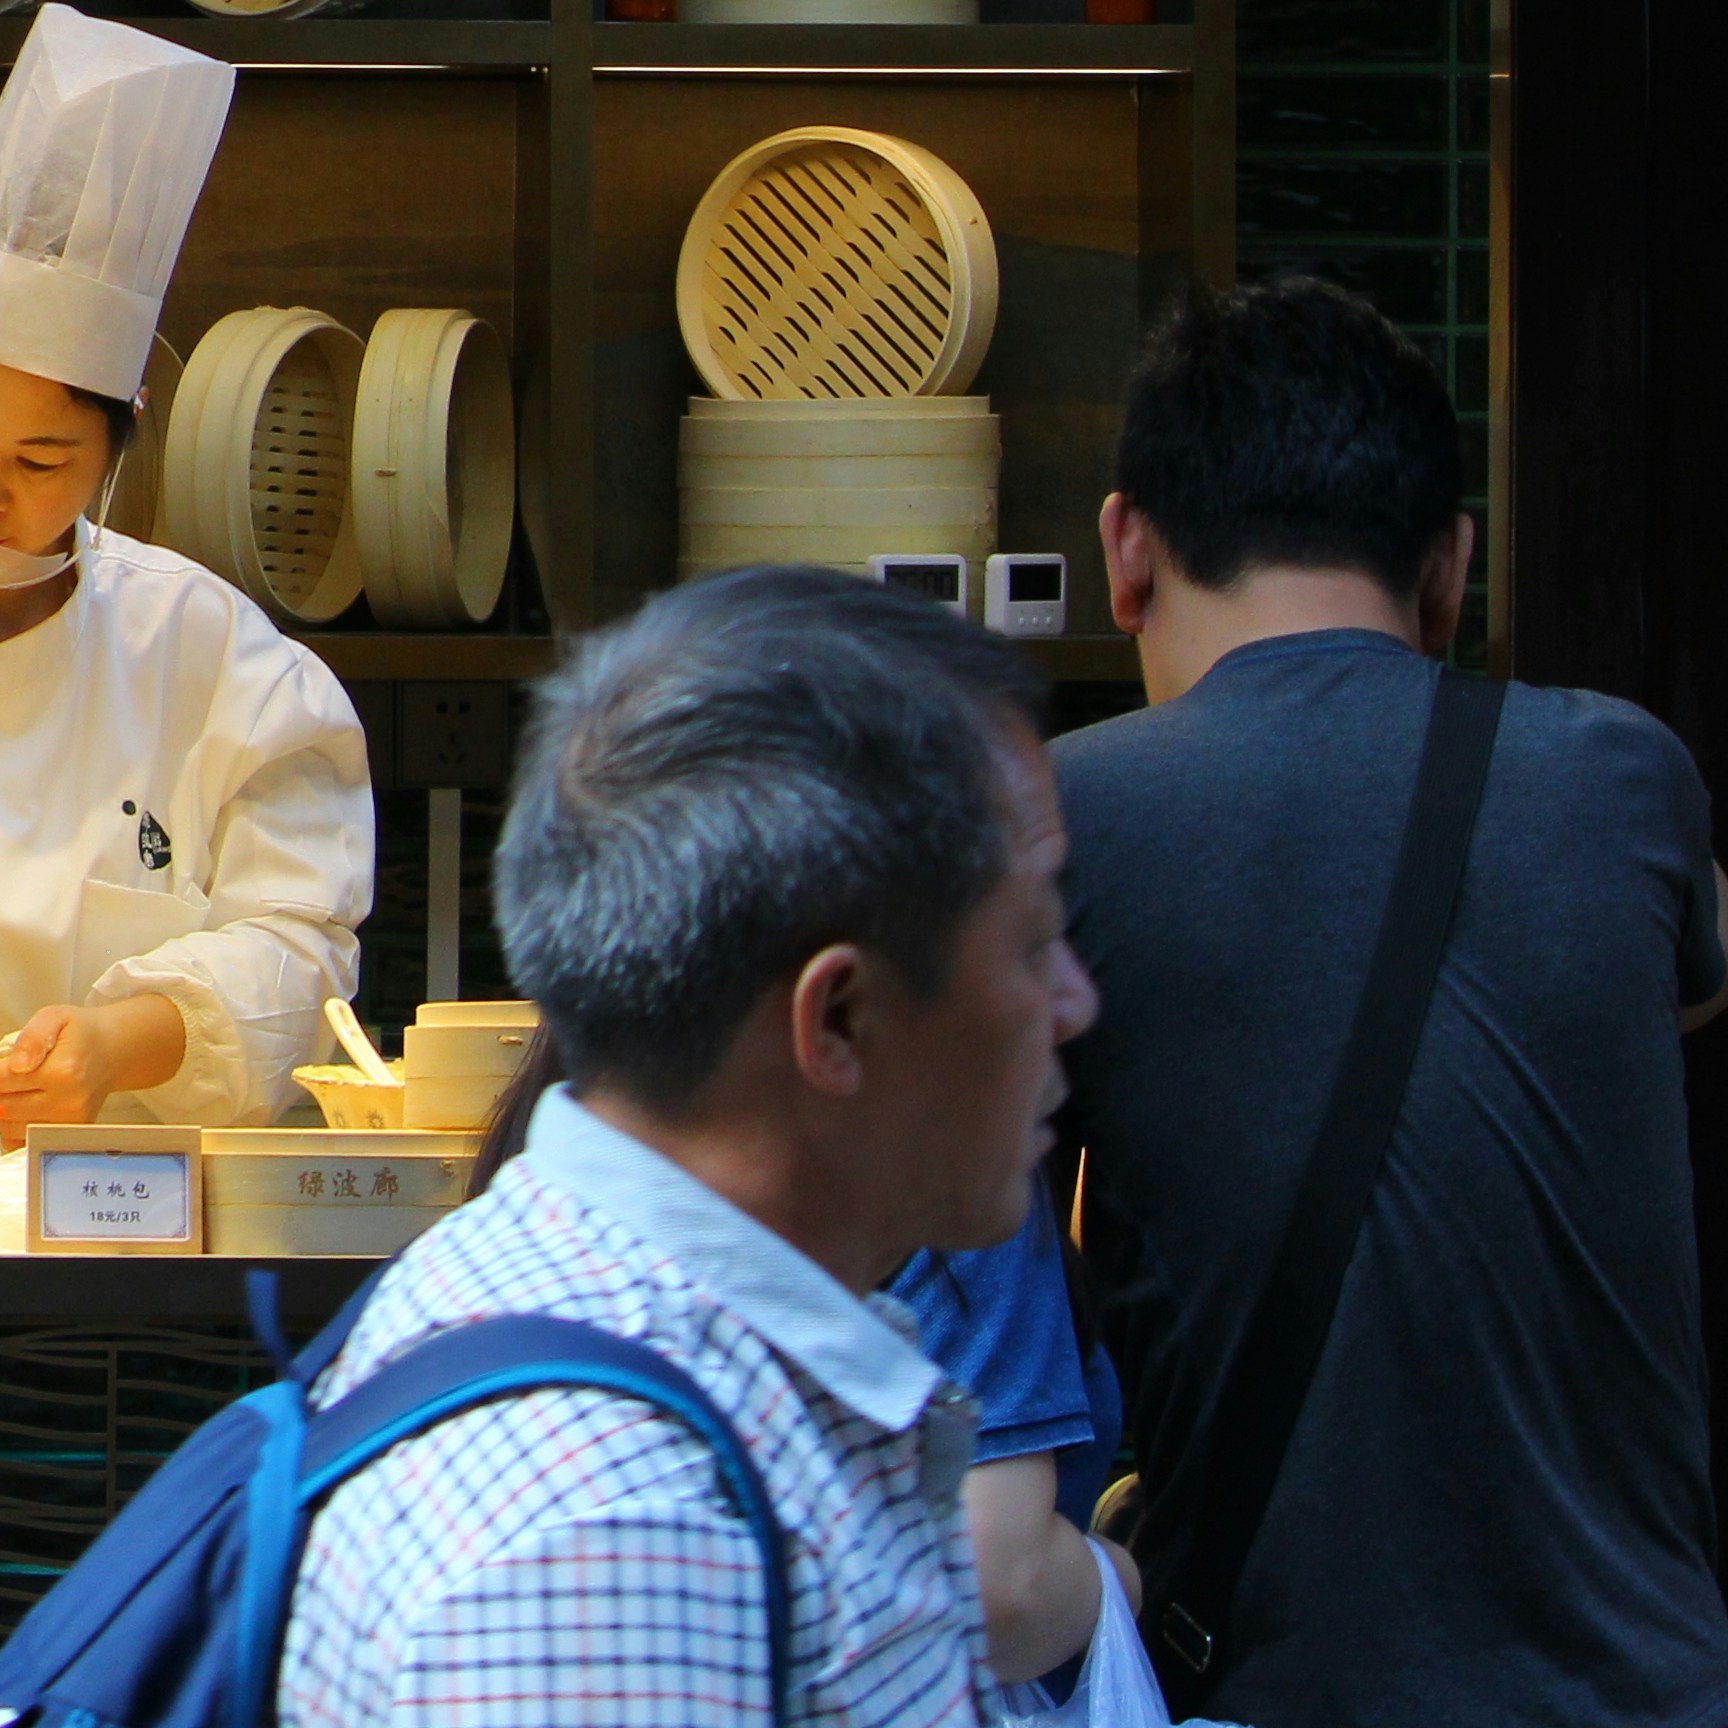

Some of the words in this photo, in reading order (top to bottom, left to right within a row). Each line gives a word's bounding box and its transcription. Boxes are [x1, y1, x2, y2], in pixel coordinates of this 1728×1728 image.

[81, 1180, 151, 1200] 核桃包
[89, 1210, 143, 1224] 18元/3只
